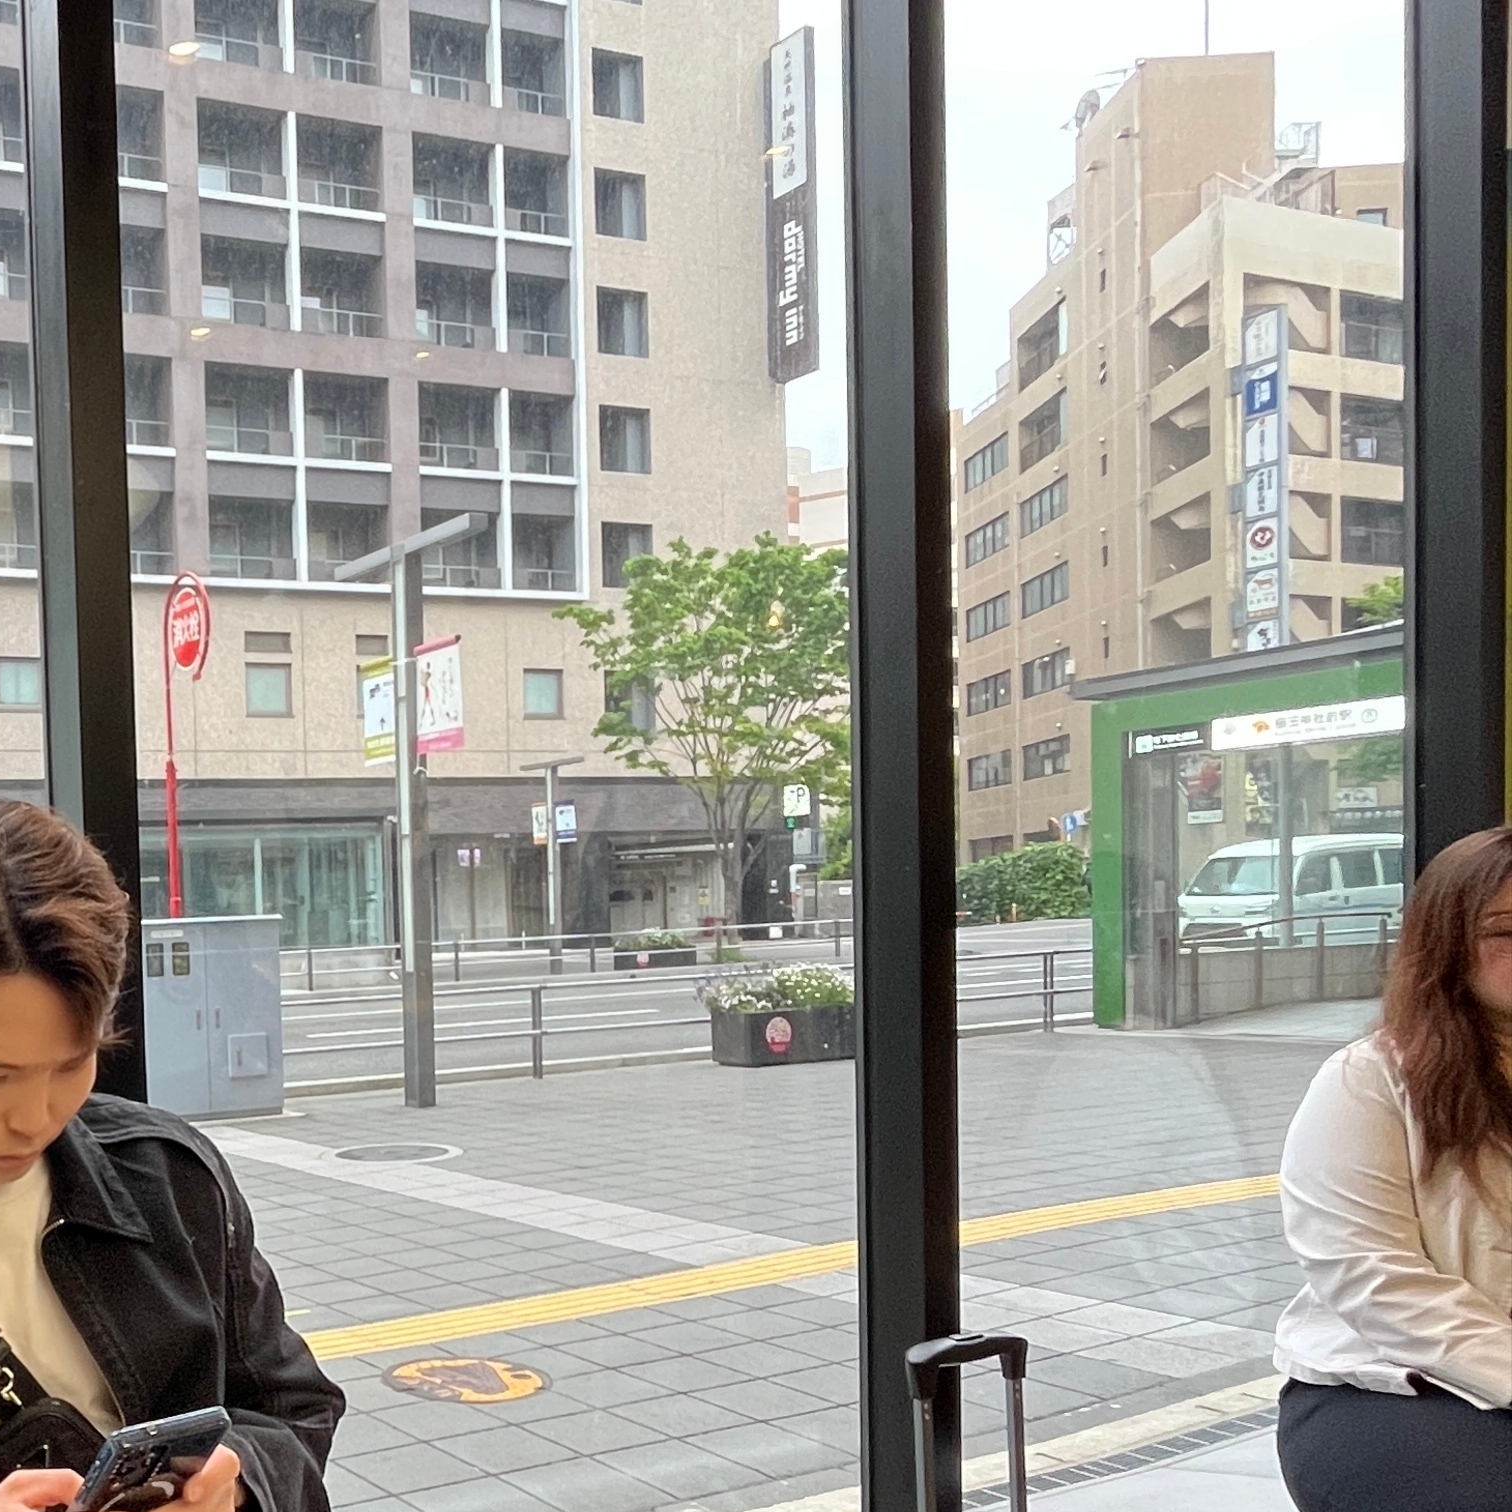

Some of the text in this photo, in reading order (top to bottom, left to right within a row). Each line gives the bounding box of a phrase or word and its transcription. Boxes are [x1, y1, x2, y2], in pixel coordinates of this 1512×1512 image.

[779, 219, 803, 346] dormy inn
[173, 609, 200, 649] 消火栓
